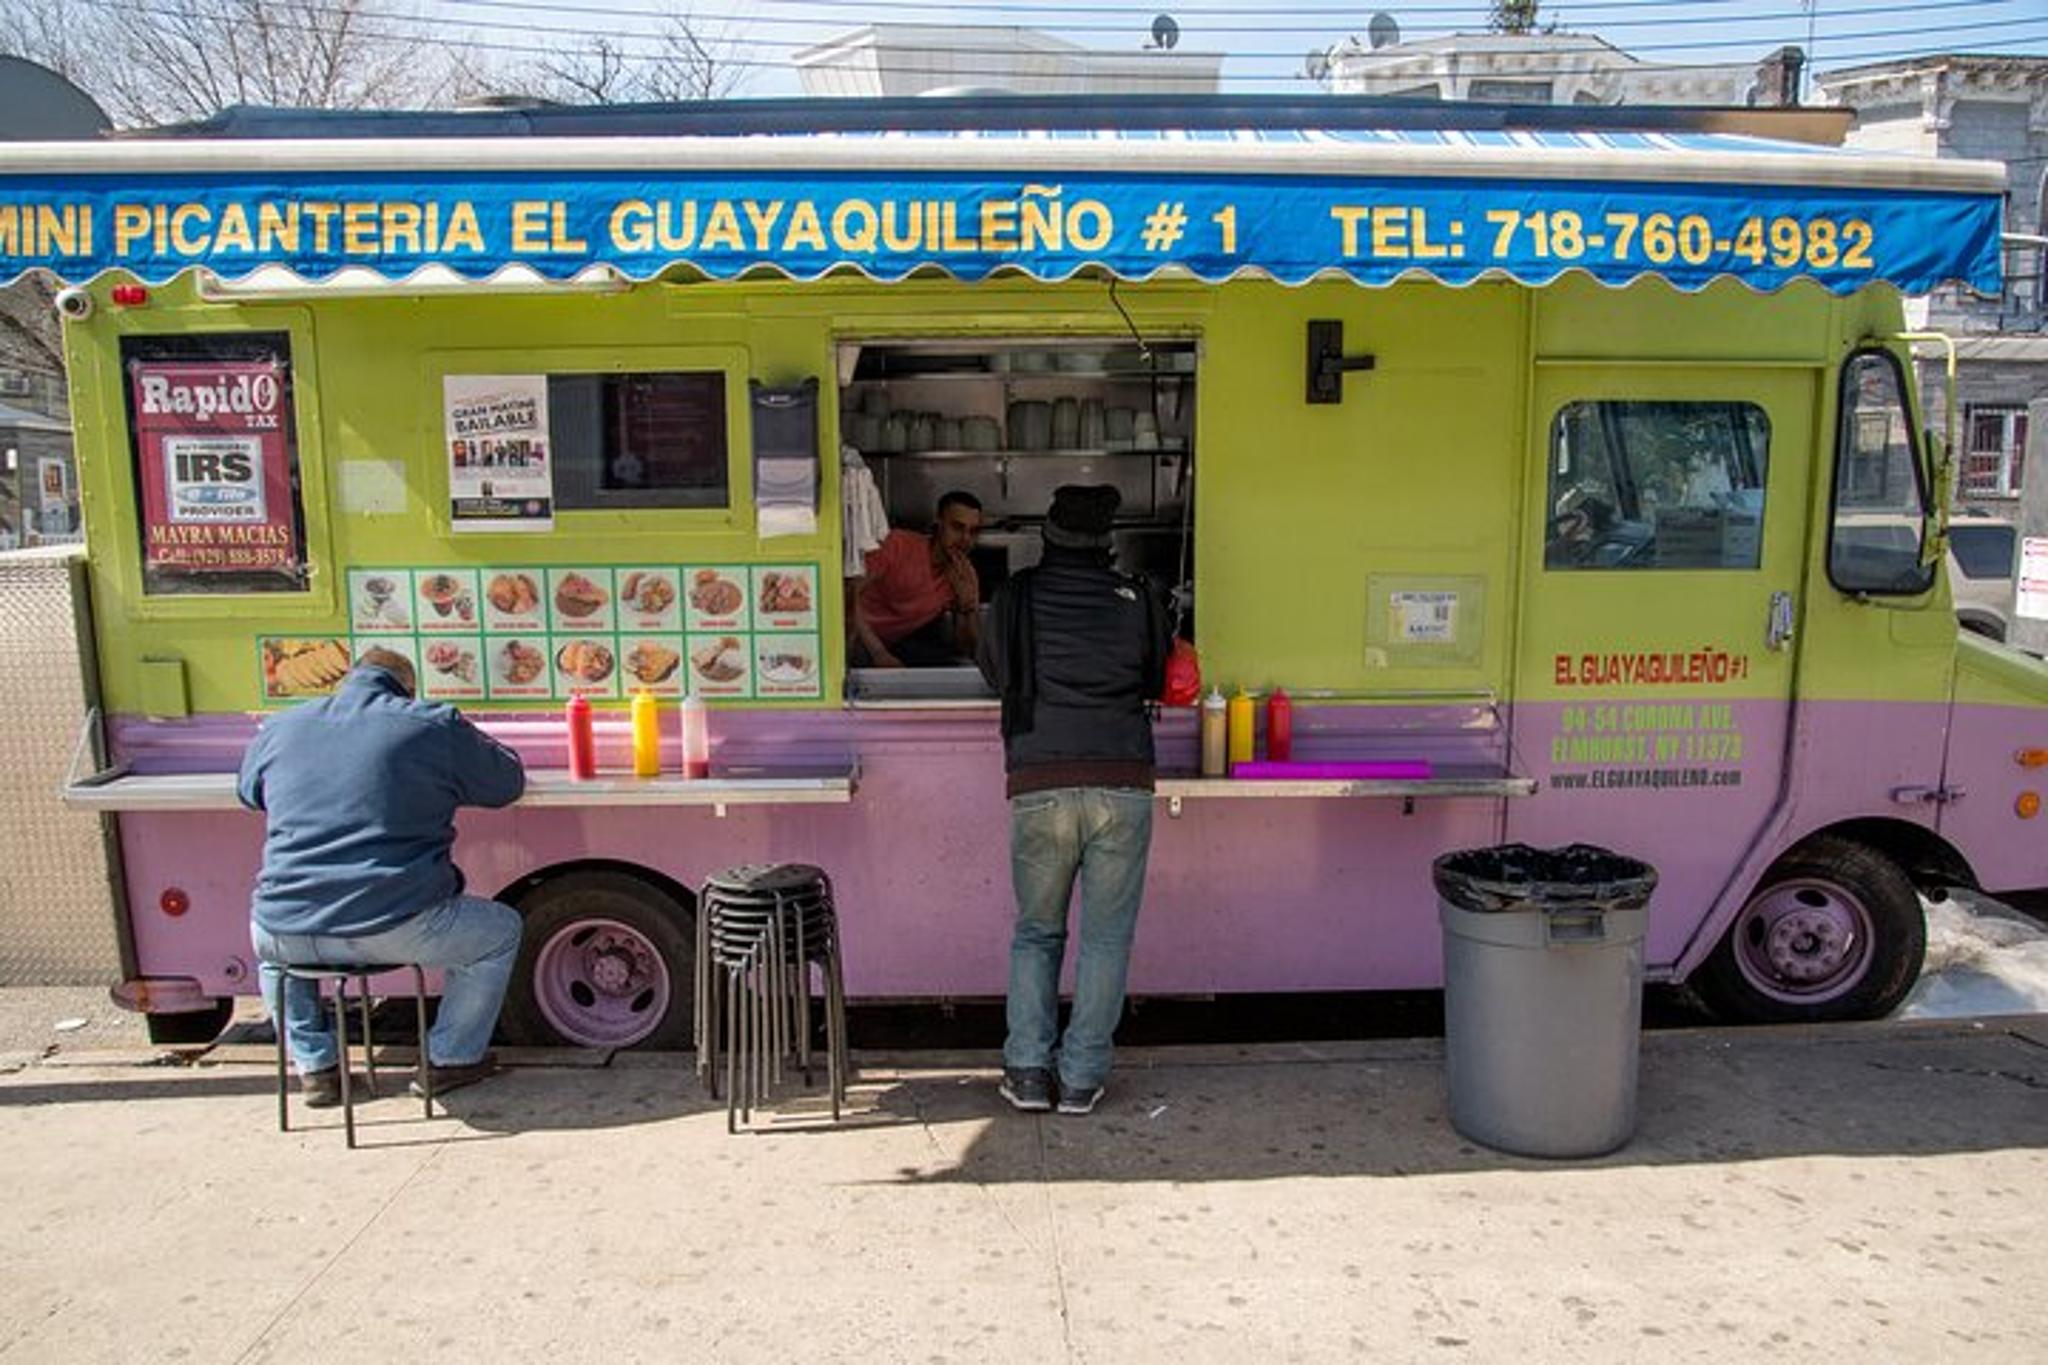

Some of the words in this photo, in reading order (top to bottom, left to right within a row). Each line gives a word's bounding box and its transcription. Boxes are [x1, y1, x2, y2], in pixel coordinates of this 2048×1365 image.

[115, 201, 485, 256] PICANTERIA
[512, 201, 587, 253] EL
[609, 184, 1112, 252] GUAYAQUILEÑO
[1142, 203, 1187, 250] #
[1213, 205, 1237, 253] 1
[1331, 206, 1464, 257] TEL:
[1486, 209, 1873, 268] 718-760-4982
[245, 414, 278, 427] TAX
[176, 453, 252, 482] IRS
[152, 525, 214, 544] MAYRA
[218, 525, 289, 544] MACIAS
[1555, 655, 1576, 684] EL
